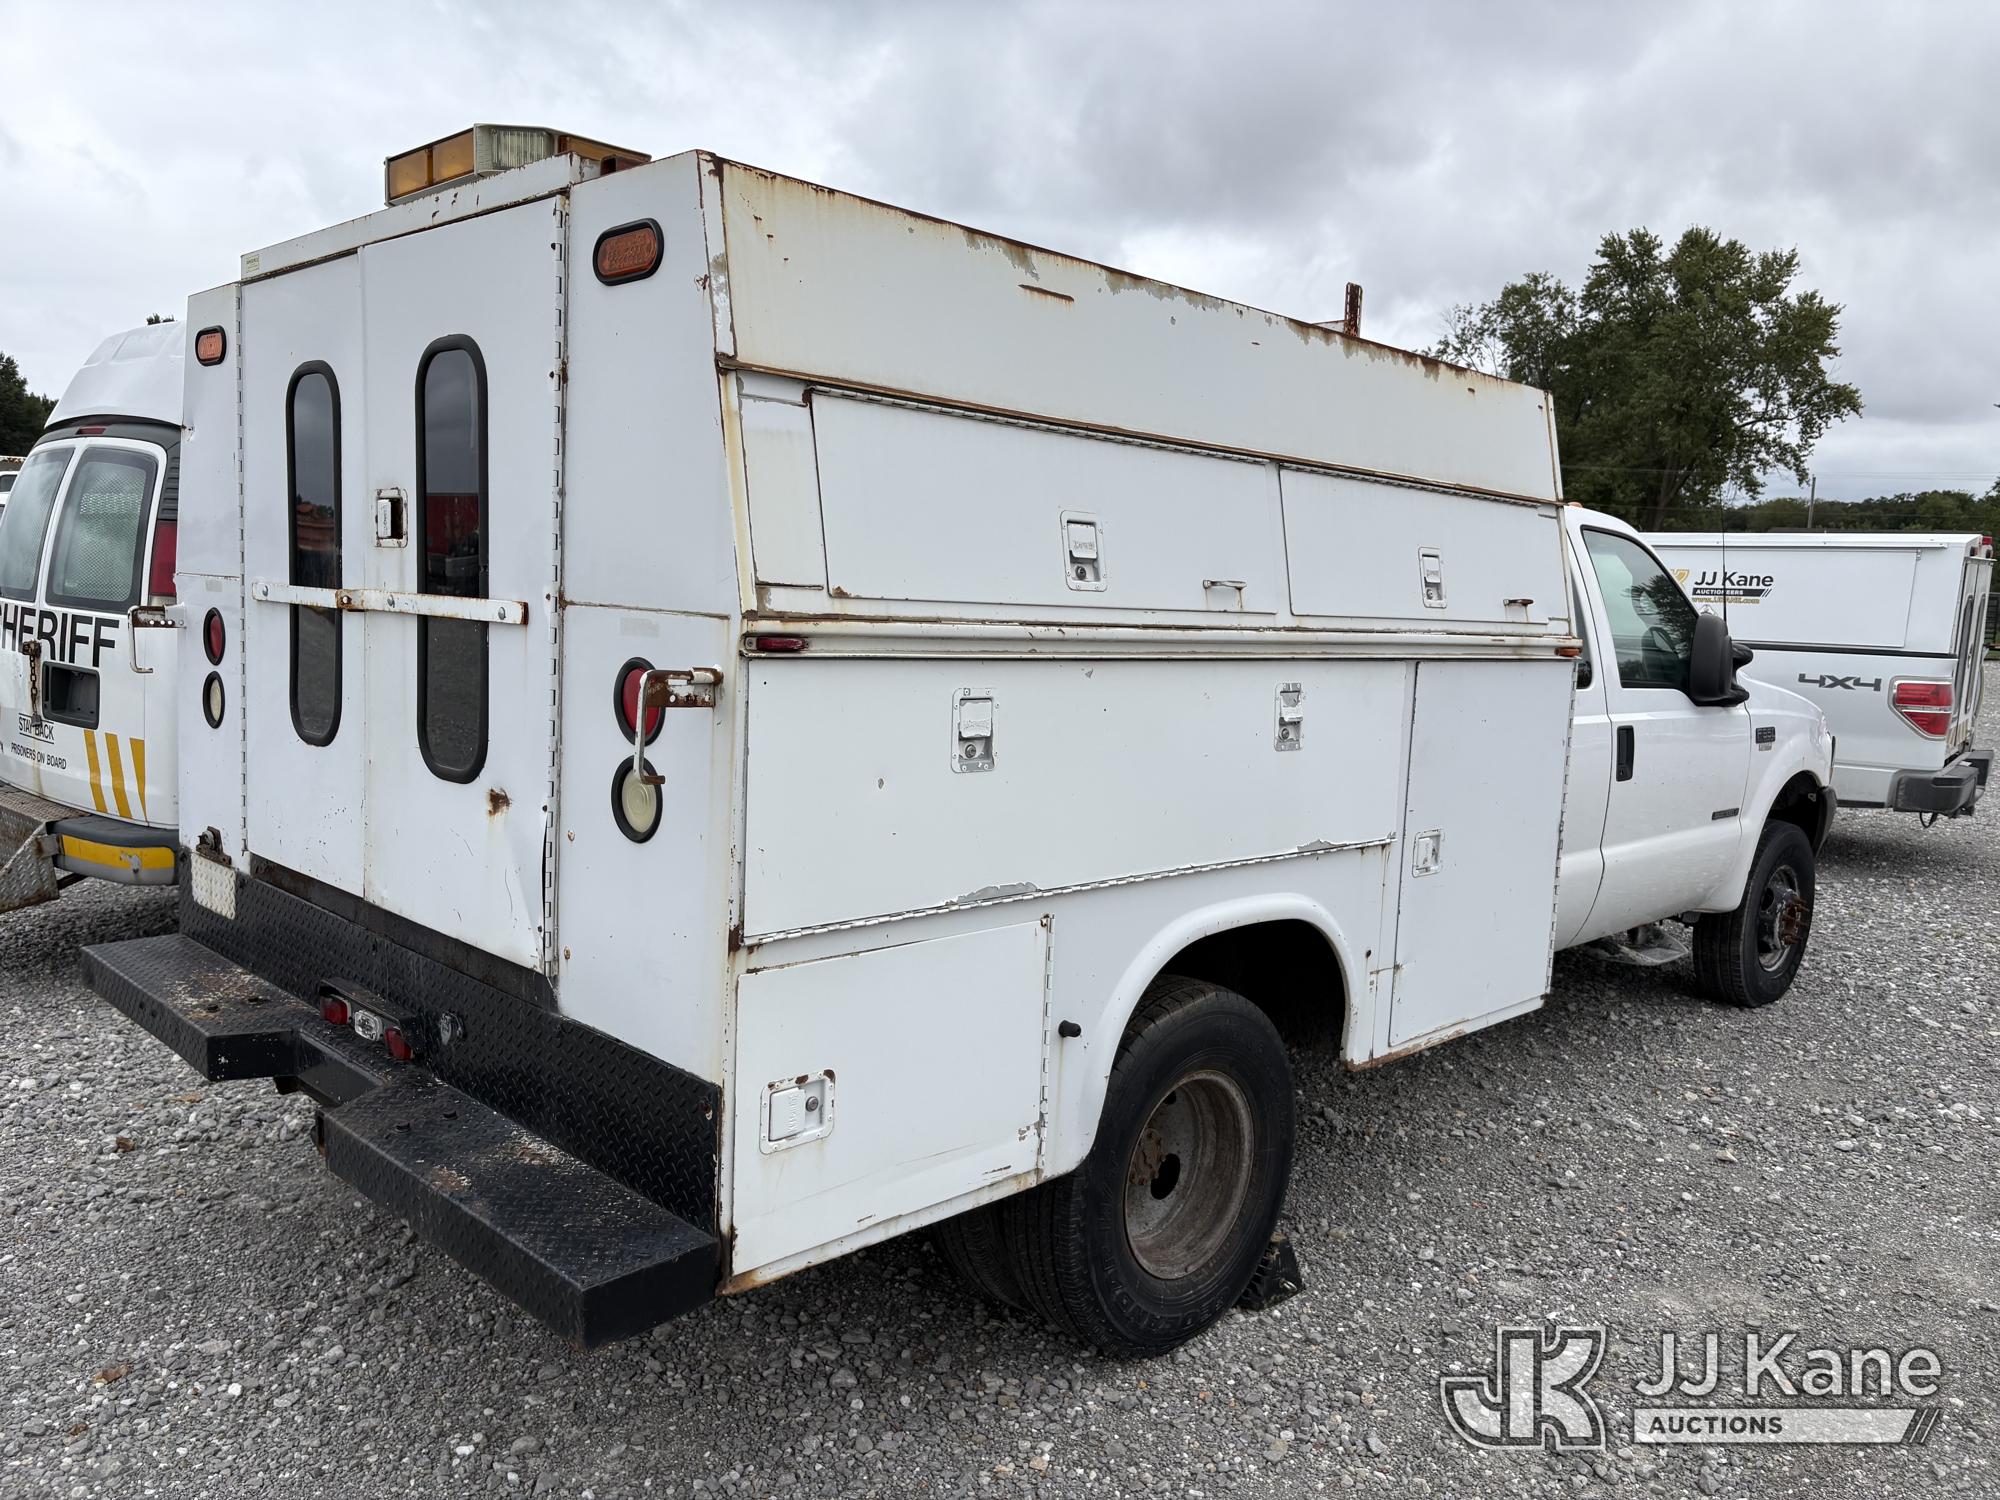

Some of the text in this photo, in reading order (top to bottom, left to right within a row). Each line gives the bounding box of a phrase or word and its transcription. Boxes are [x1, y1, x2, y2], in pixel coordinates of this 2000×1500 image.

[1694, 571, 1717, 586] JJ
[1722, 571, 1774, 587] Kane
[0, 603, 120, 668] HERIFF
[34, 721, 55, 741] BACK
[46, 754, 67, 770] BOARD
